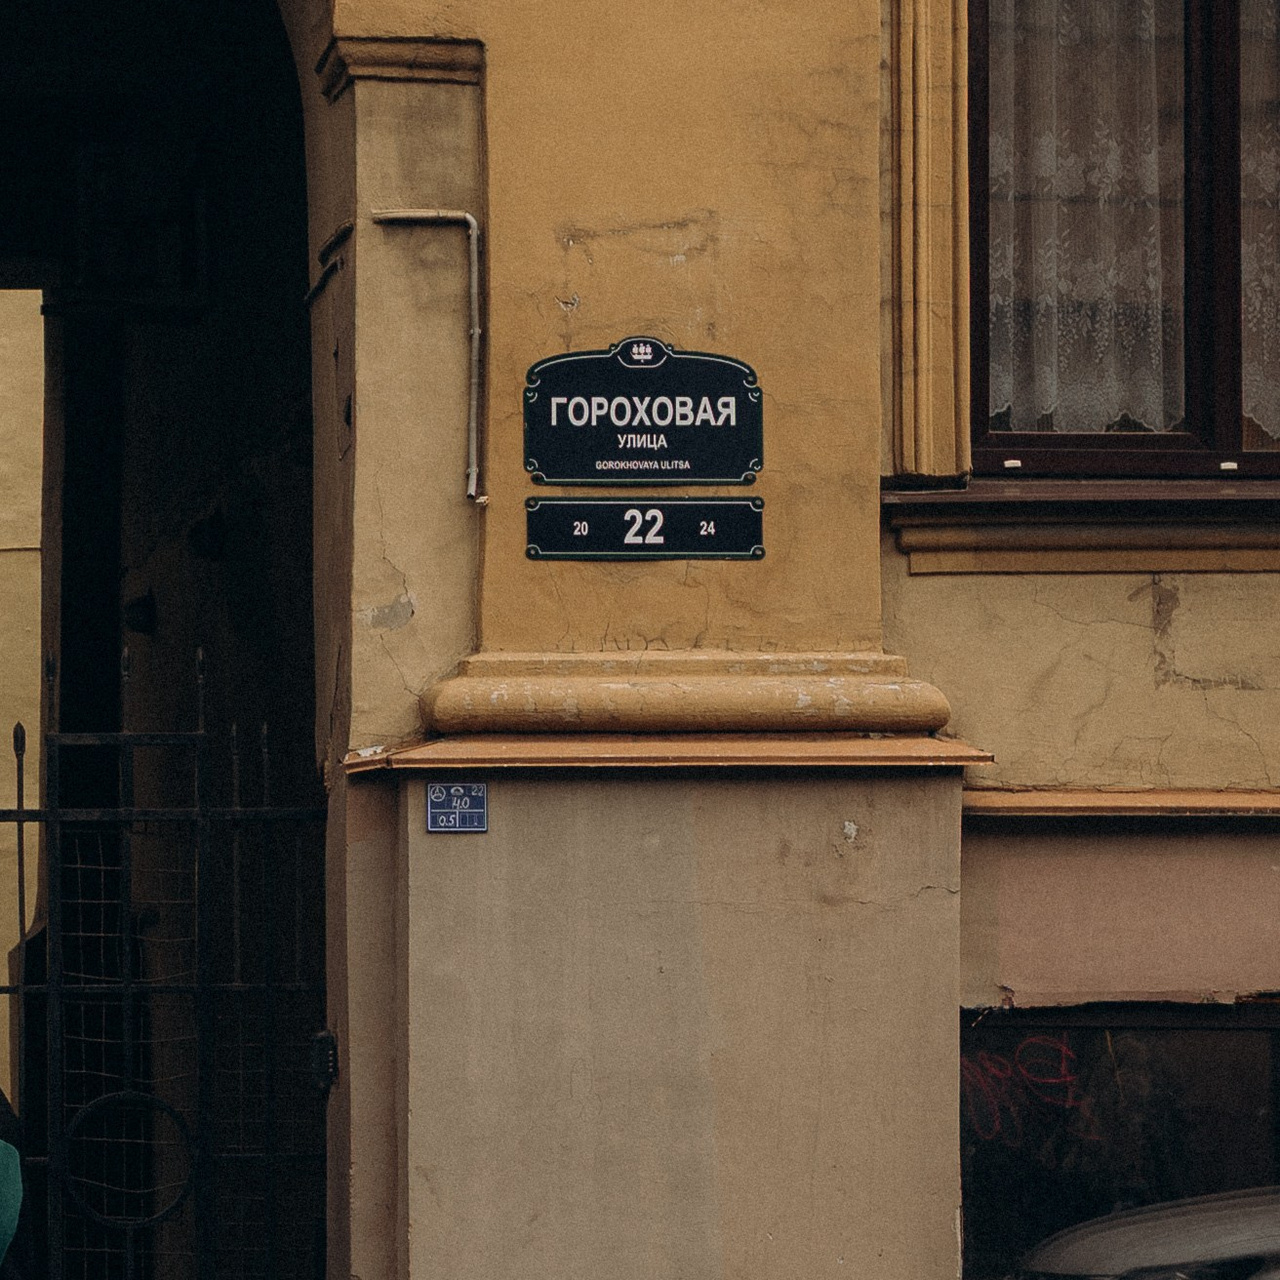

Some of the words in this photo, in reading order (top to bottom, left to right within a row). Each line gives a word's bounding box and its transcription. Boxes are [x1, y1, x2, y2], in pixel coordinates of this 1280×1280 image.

[551, 396, 736, 426] ГОРОХОВАЯ
[617, 434, 668, 450] УЛИЦА
[595, 460, 659, 470] GOROKHOVAYA
[660, 460, 690, 470] ULITSA
[573, 521, 589, 536] 20
[623, 509, 664, 544] 22
[699, 521, 716, 536] 24
[471, 785, 484, 796] 22
[439, 814, 456, 827] 0.5
